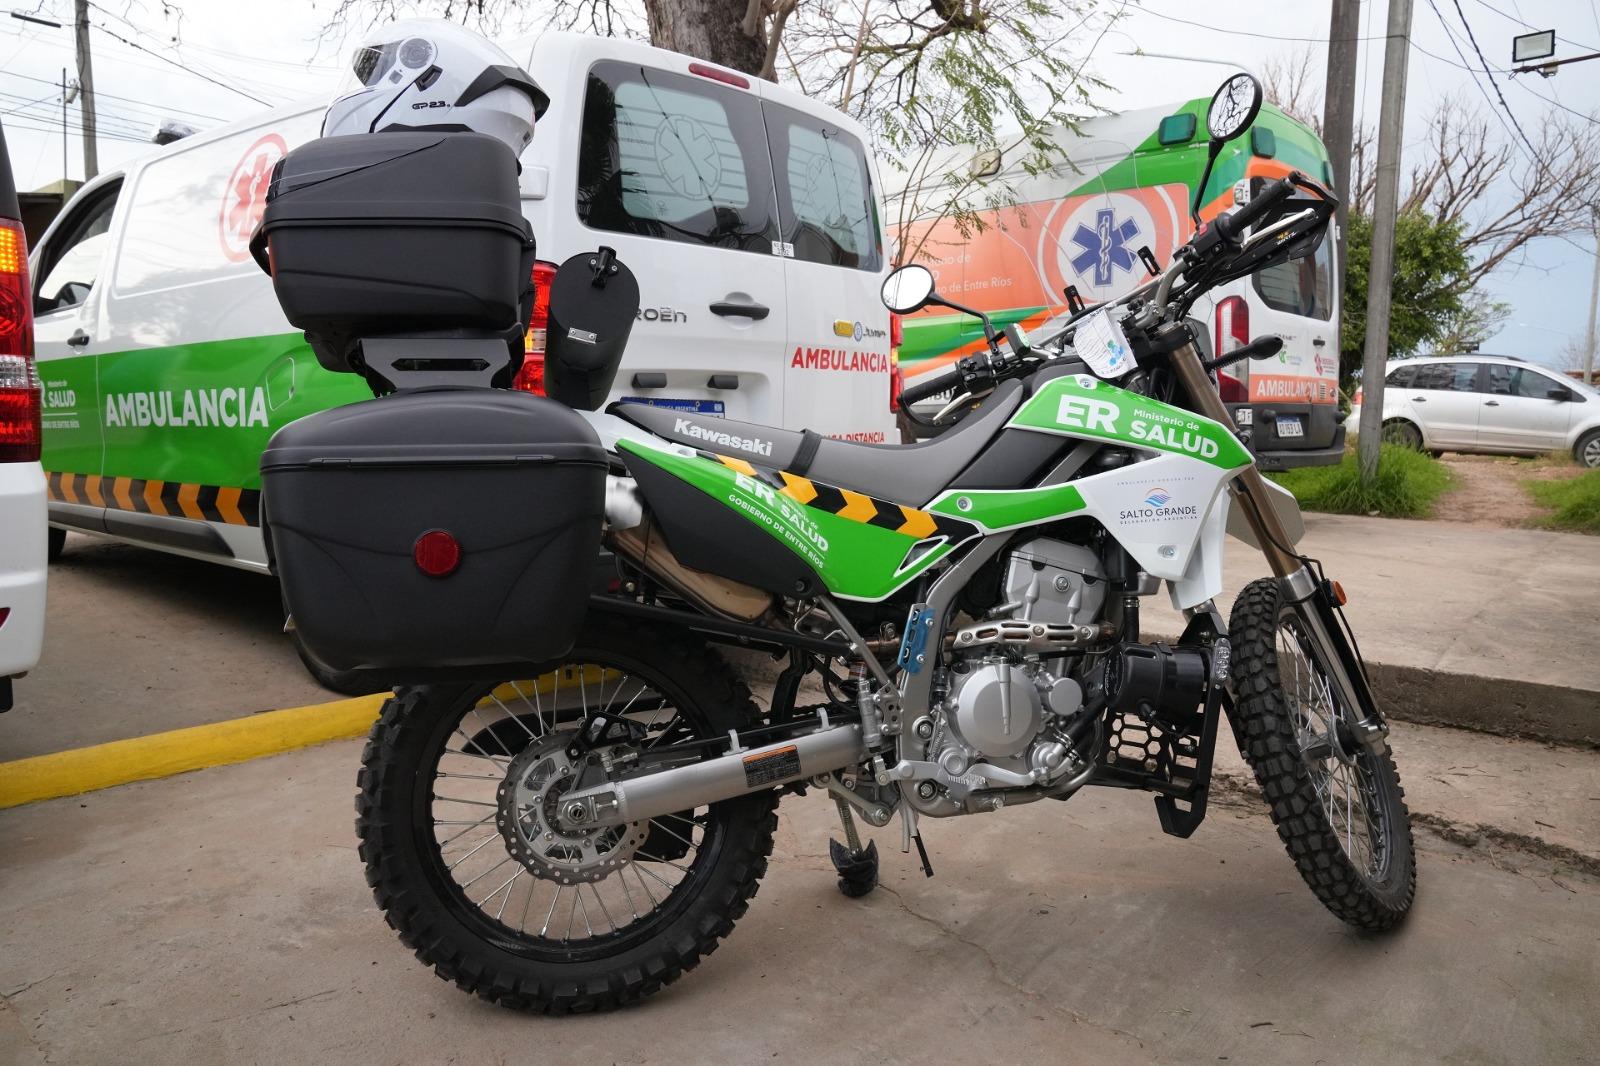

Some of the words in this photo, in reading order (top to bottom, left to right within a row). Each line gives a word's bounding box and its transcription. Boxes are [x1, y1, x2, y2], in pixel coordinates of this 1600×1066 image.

[964, 279, 989, 292] Entre
[991, 276, 1012, 288] Ríos
[791, 347, 888, 373] AMBULANCIA
[48, 389, 76, 408] SALUD
[1256, 379, 1317, 399] AMBULANCIA
[106, 386, 269, 428] AMBULANCIA
[1056, 394, 1120, 434] ER
[1133, 408, 1184, 428] Ministerio
[1186, 421, 1200, 431] de
[674, 418, 773, 457] Kawasaki
[846, 432, 885, 443] DISTANCIA
[1129, 420, 1219, 459] SALUD
[735, 471, 776, 507] ER
[729, 494, 773, 525] GOBIERNO
[773, 522, 785, 534] DE
[785, 531, 808, 554] ENTRE
[781, 504, 829, 552] SALUD
[1120, 509, 1153, 520] SALTO
[1155, 506, 1197, 517] GRANDE
